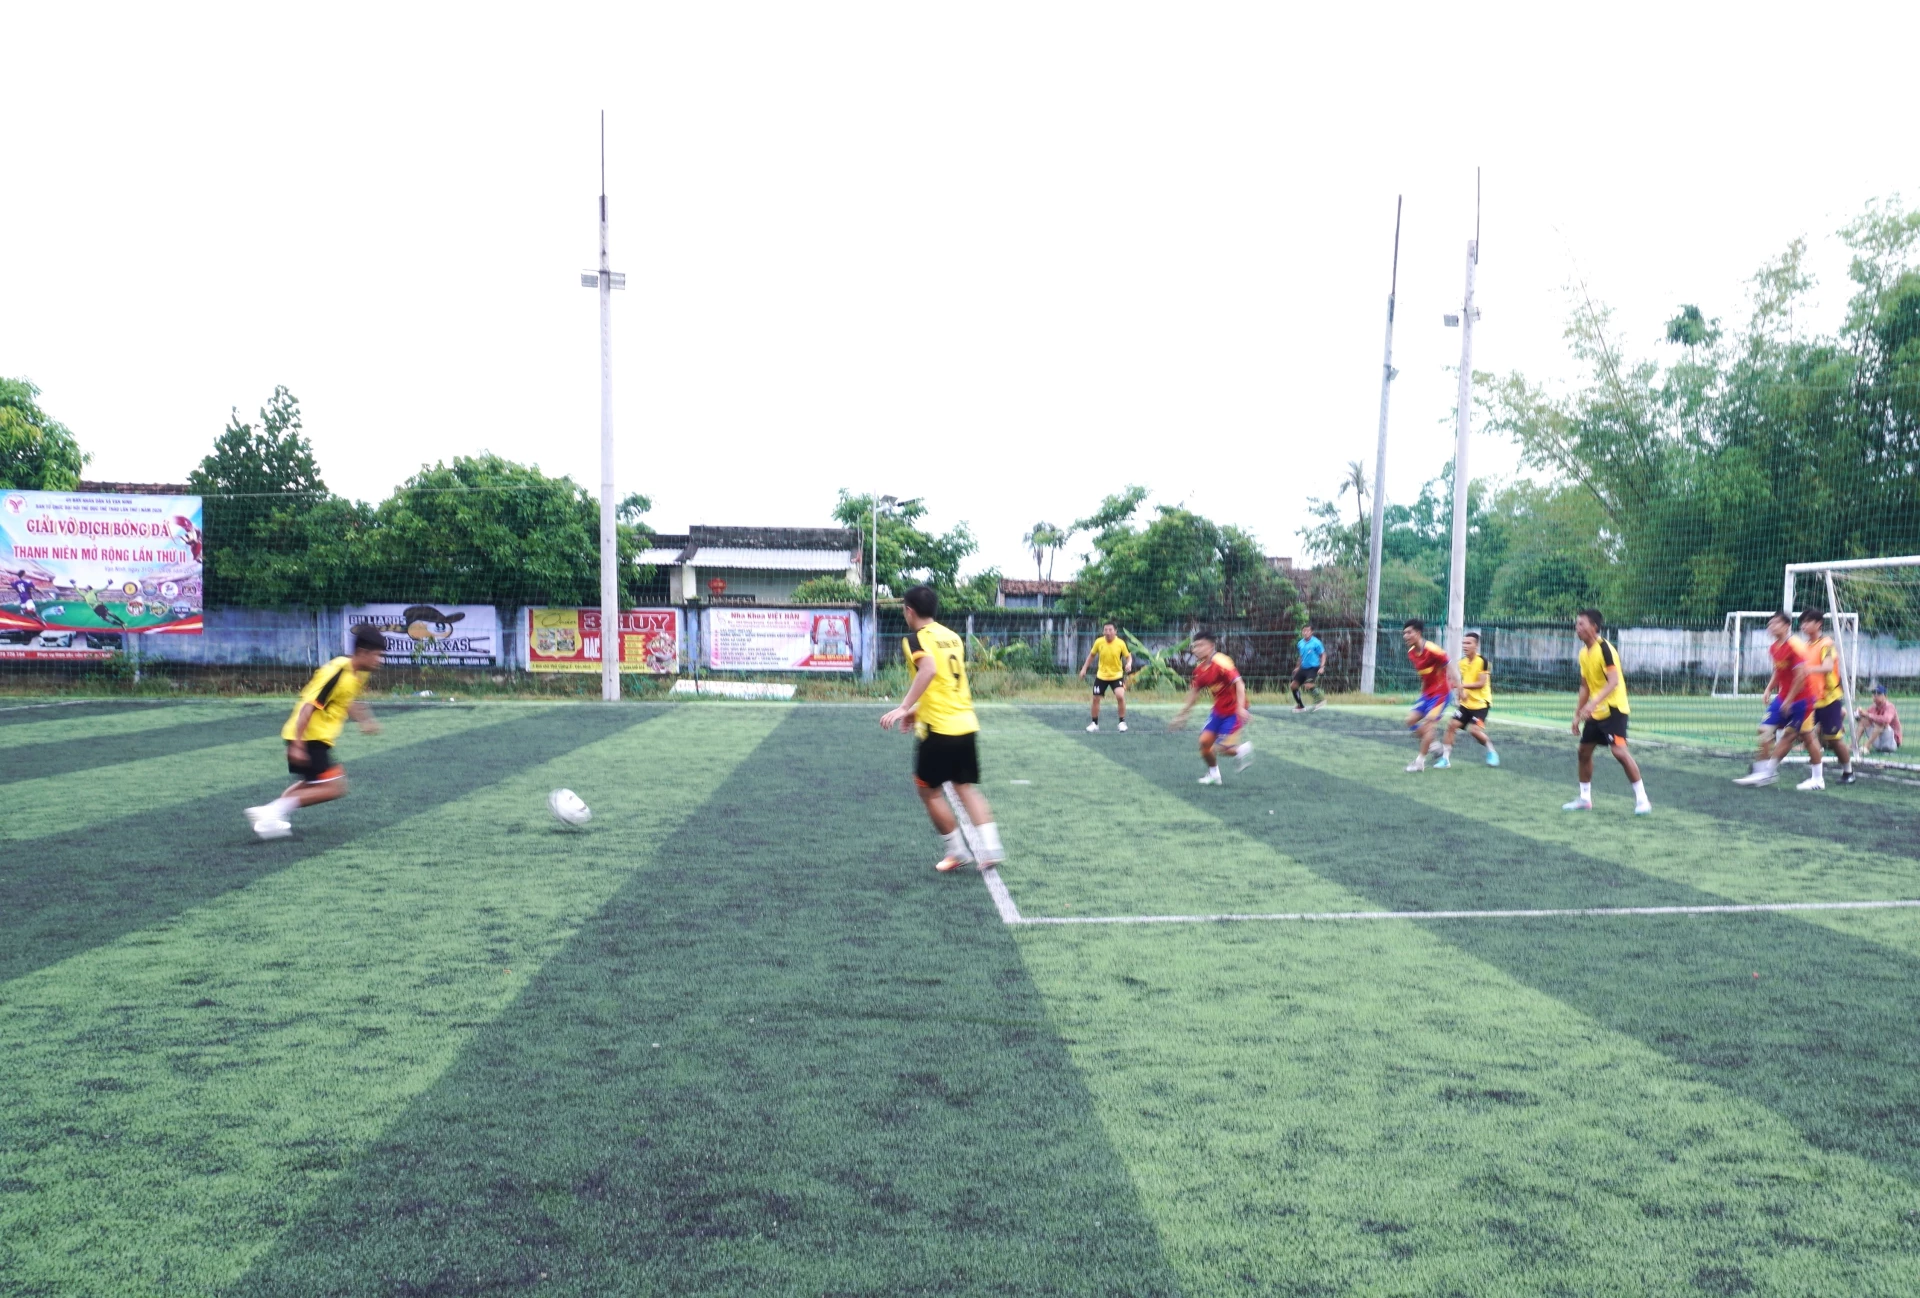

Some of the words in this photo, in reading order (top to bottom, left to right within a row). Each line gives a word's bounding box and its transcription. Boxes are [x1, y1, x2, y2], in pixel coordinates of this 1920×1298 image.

[26, 513, 54, 533] GIẢI
[79, 520, 109, 539] ĐỊCH
[113, 518, 147, 536] BÓNG
[151, 519, 169, 537] ĐÁ
[13, 545, 49, 559] THANH
[52, 544, 78, 560] NIÊN
[81, 543, 99, 561] MỞ
[101, 545, 129, 564] RỘNG
[132, 545, 153, 562] LẦN
[156, 547, 177, 563] THỨ
[179, 549, 187, 563] II
[349, 614, 407, 626] BILLIARDS
